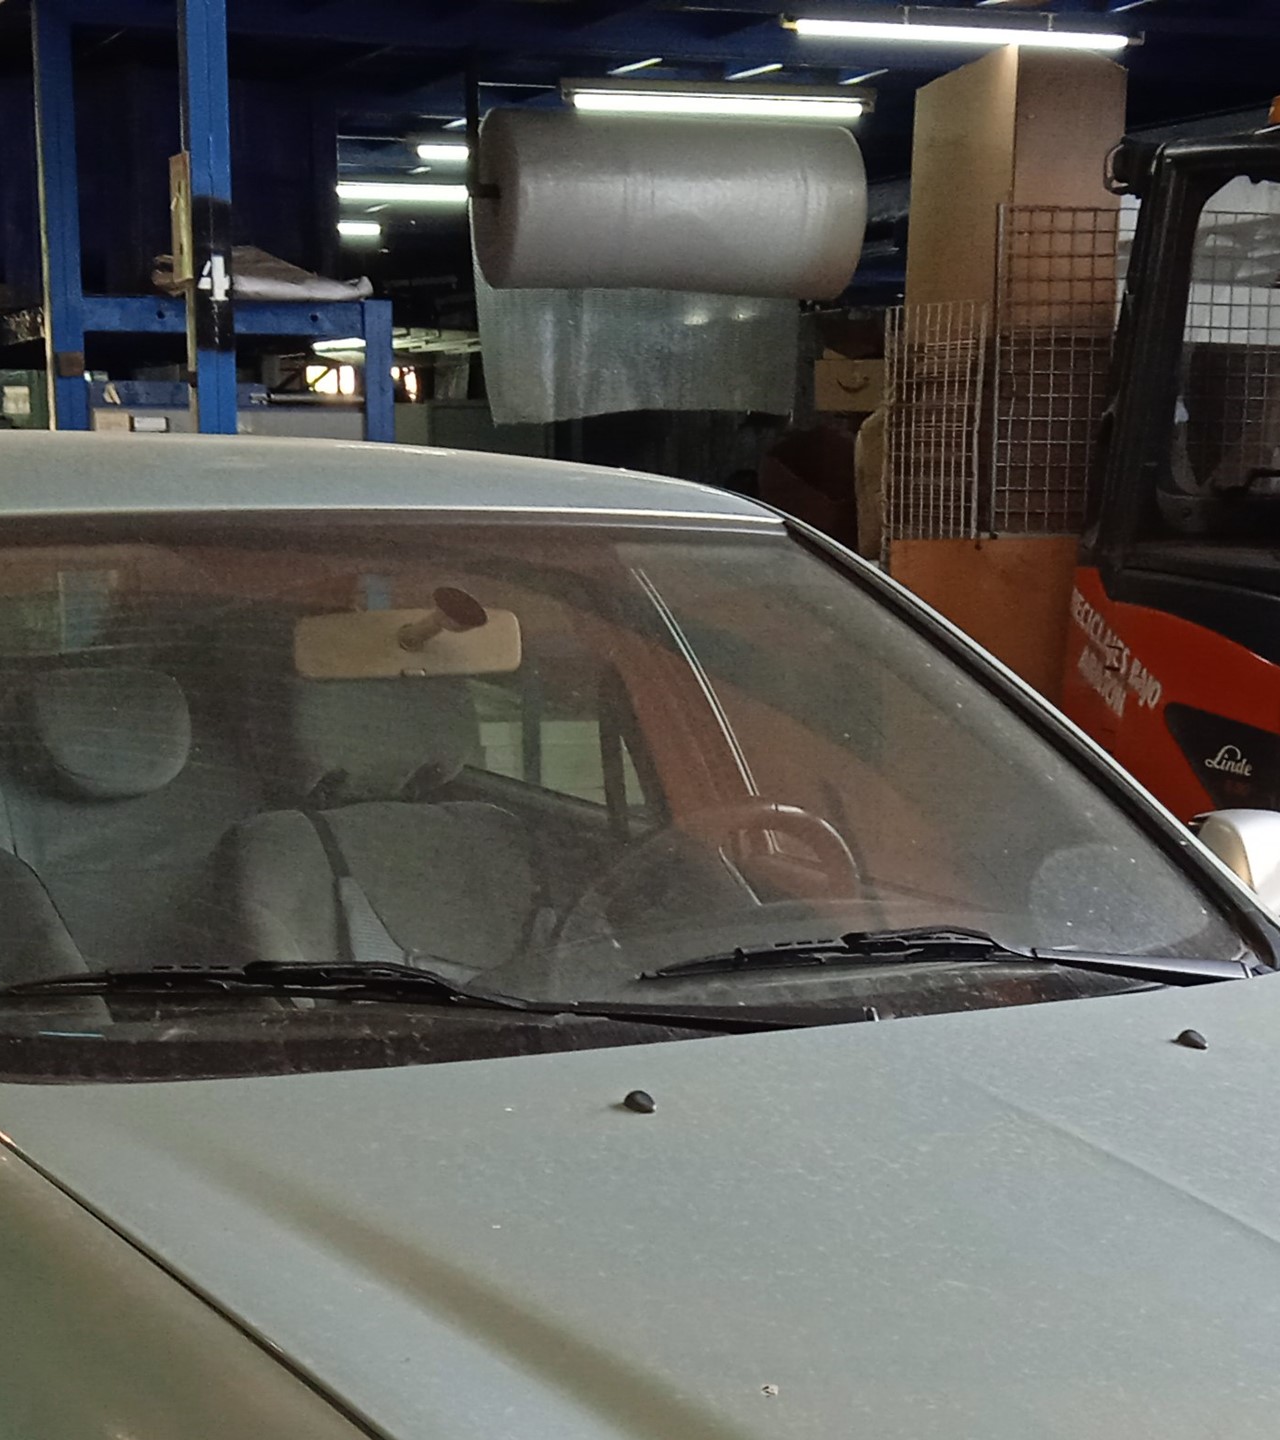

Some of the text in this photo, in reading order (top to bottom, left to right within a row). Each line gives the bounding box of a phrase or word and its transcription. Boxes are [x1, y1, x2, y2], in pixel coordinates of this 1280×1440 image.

[197, 255, 231, 301] 4
[1128, 657, 1162, 710] BAJO
[1204, 745, 1253, 776] Linde
